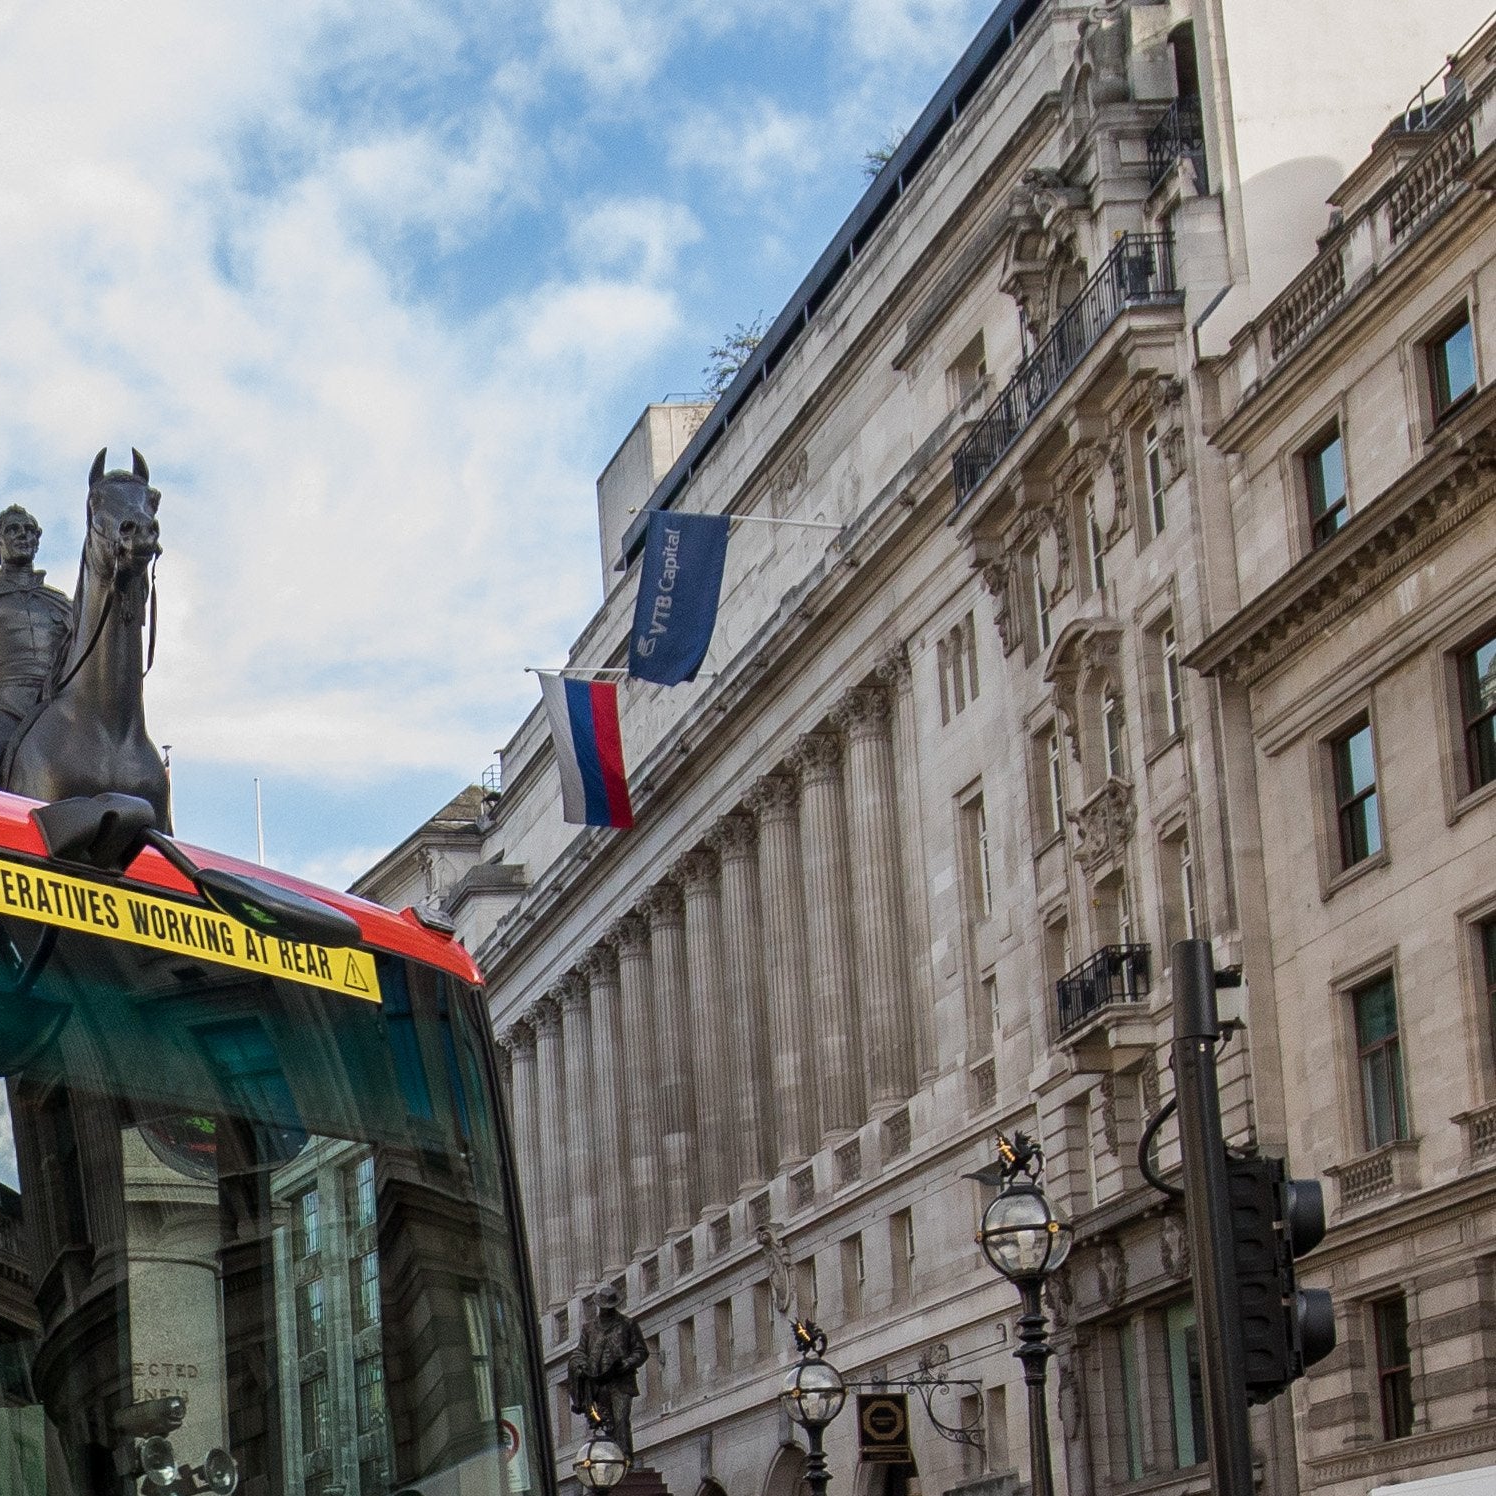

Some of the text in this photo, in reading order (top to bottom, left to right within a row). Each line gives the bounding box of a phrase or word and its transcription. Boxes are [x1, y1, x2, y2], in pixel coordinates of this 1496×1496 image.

[649, 528, 681, 635] VTB Capital
[129, 900, 235, 957] WORKING
[244, 926, 269, 962] AT
[277, 940, 334, 981] REAR
